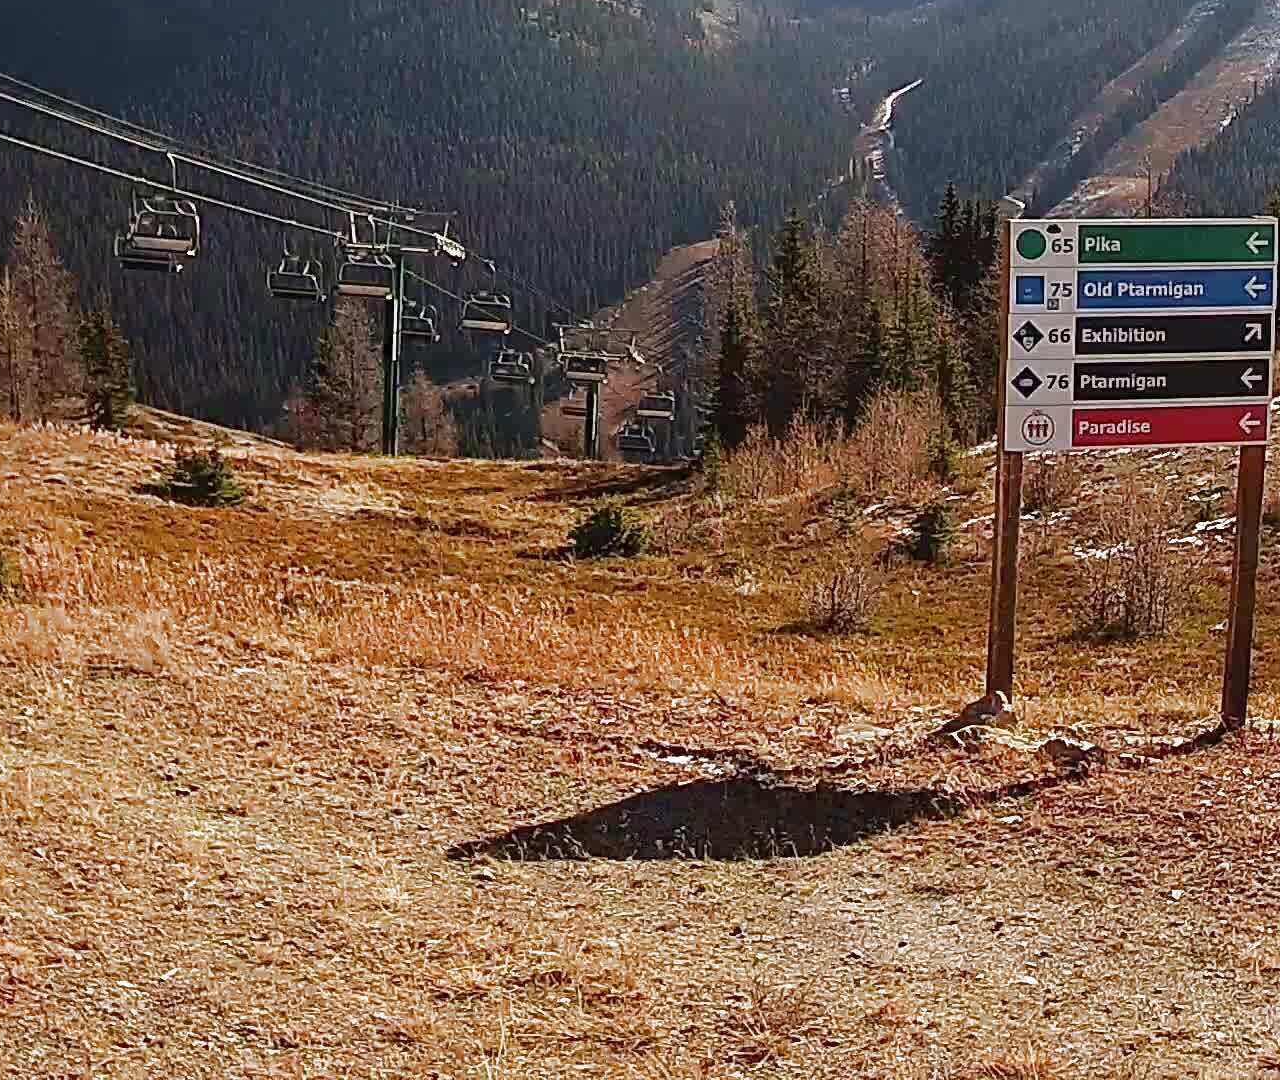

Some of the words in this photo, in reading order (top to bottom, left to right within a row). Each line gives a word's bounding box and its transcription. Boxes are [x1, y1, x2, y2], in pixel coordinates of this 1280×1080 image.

[1051, 238, 1074, 254] 65
[1084, 236, 1121, 252] Pika
[1050, 282, 1073, 298] 75
[1083, 281, 1112, 297] Old
[1117, 281, 1204, 298] Ptarmigan
[1048, 328, 1071, 344] 66
[1081, 327, 1167, 343] Exhibition
[1046, 374, 1069, 390] 76
[1079, 373, 1167, 391] Ptarmigan
[1078, 419, 1151, 436] Paradise
